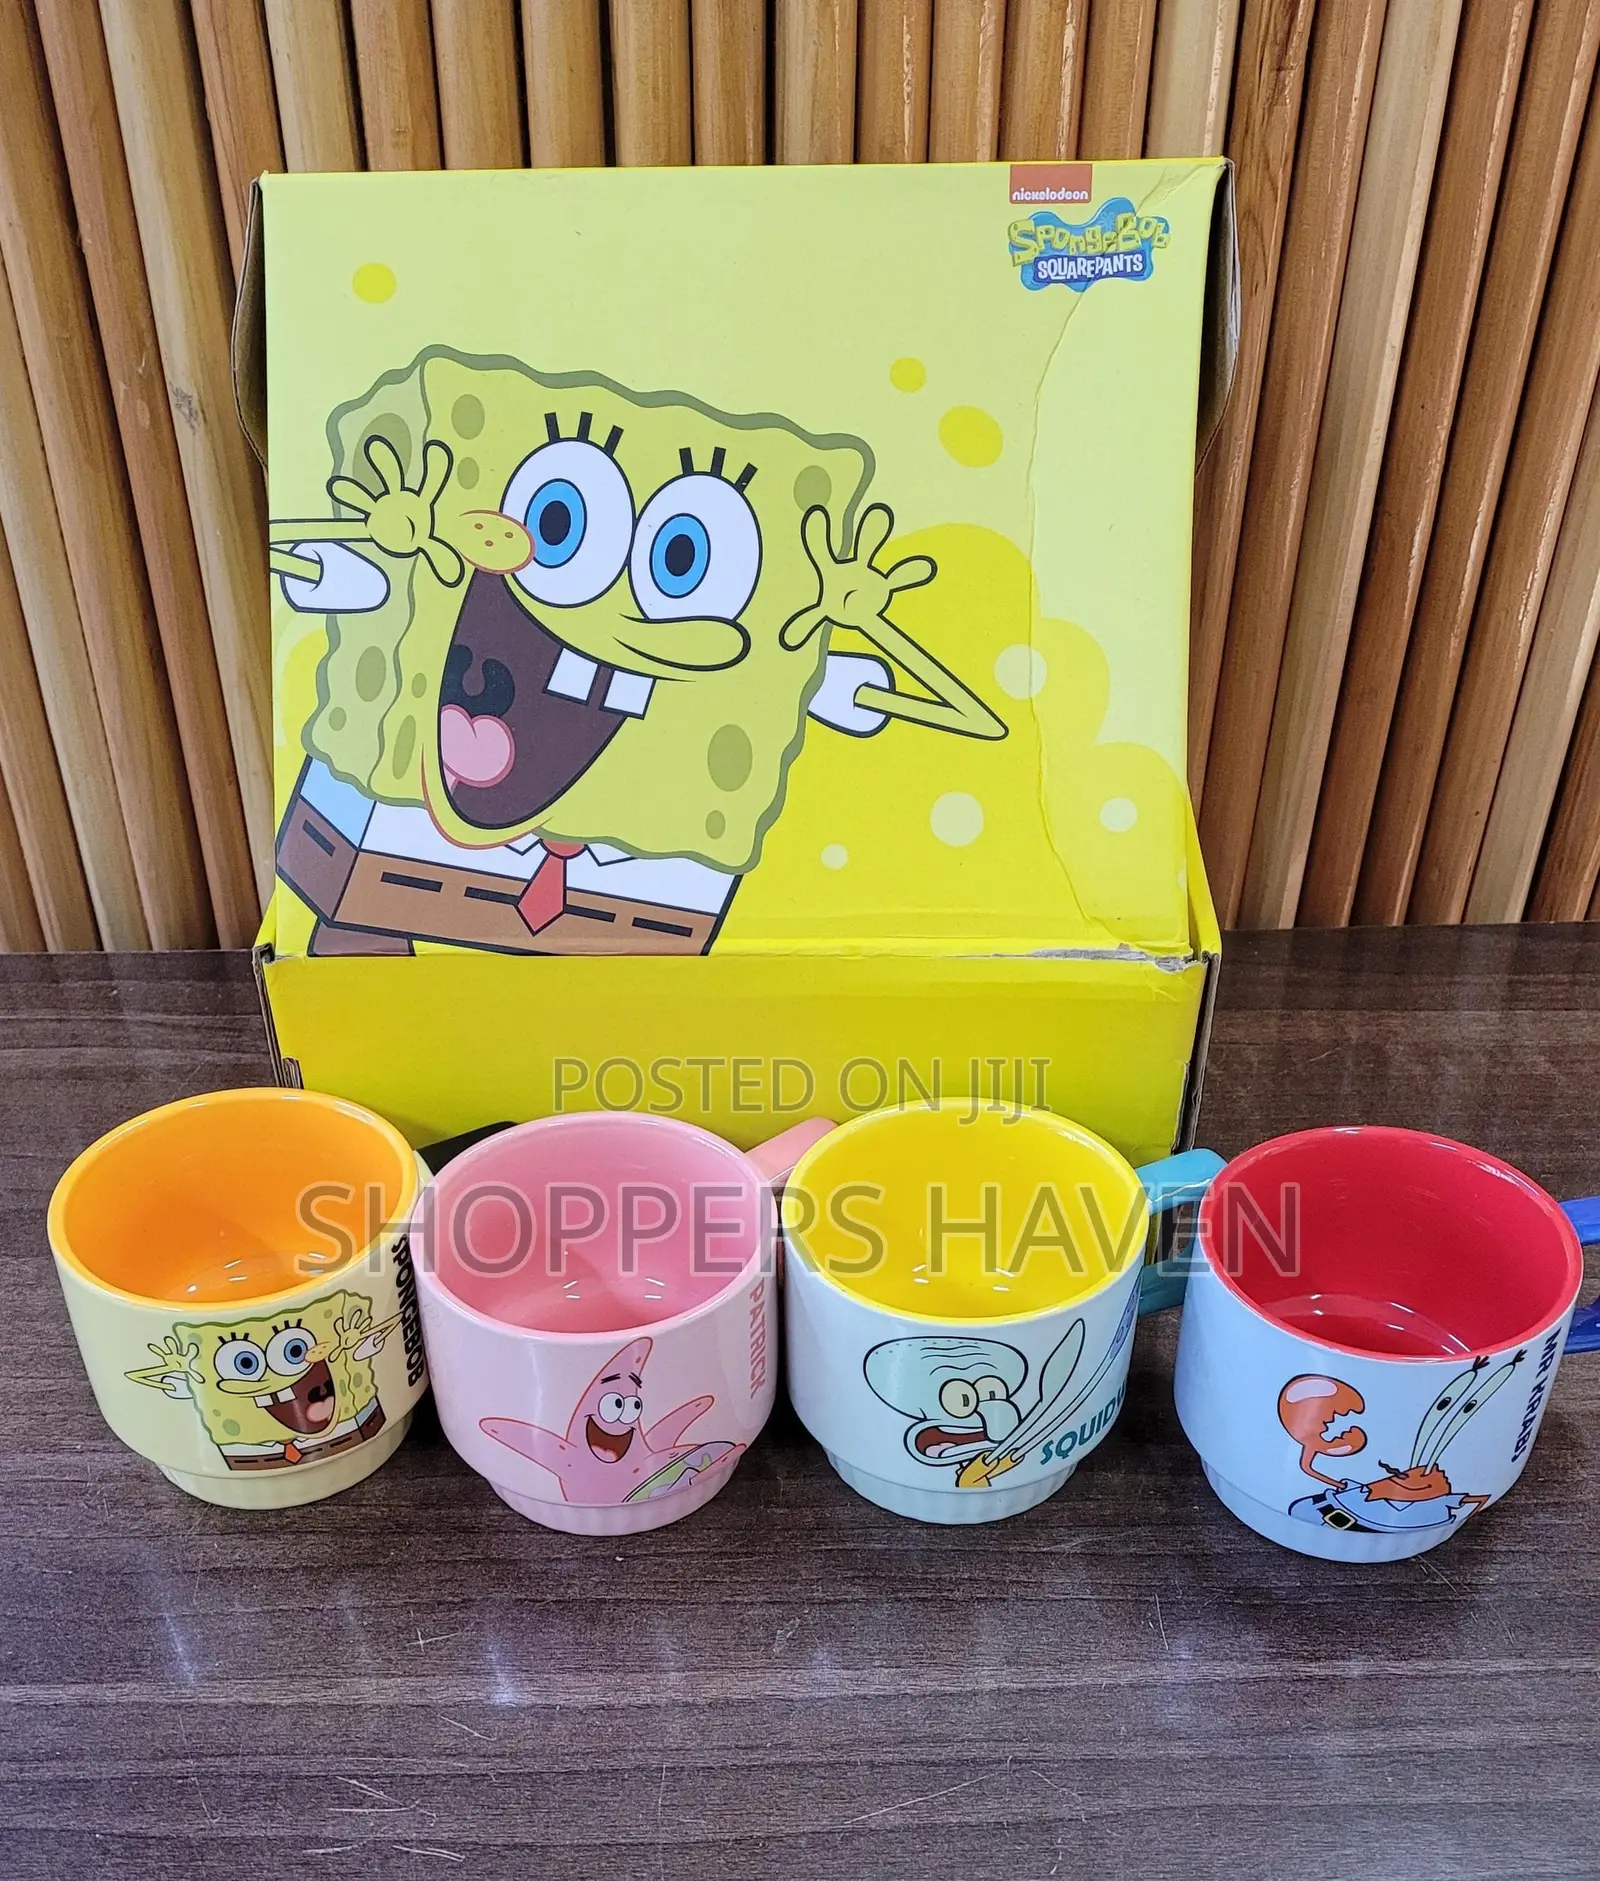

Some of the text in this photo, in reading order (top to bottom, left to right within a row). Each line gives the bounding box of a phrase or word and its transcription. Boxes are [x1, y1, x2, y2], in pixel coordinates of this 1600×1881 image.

[1012, 187, 1089, 201] nickelodeon
[1037, 254, 1143, 280] SQUAREPANTS
[391, 1234, 424, 1387] SPONGEBOB
[749, 1277, 765, 1399] PATRICK
[1536, 1326, 1562, 1379] MR
